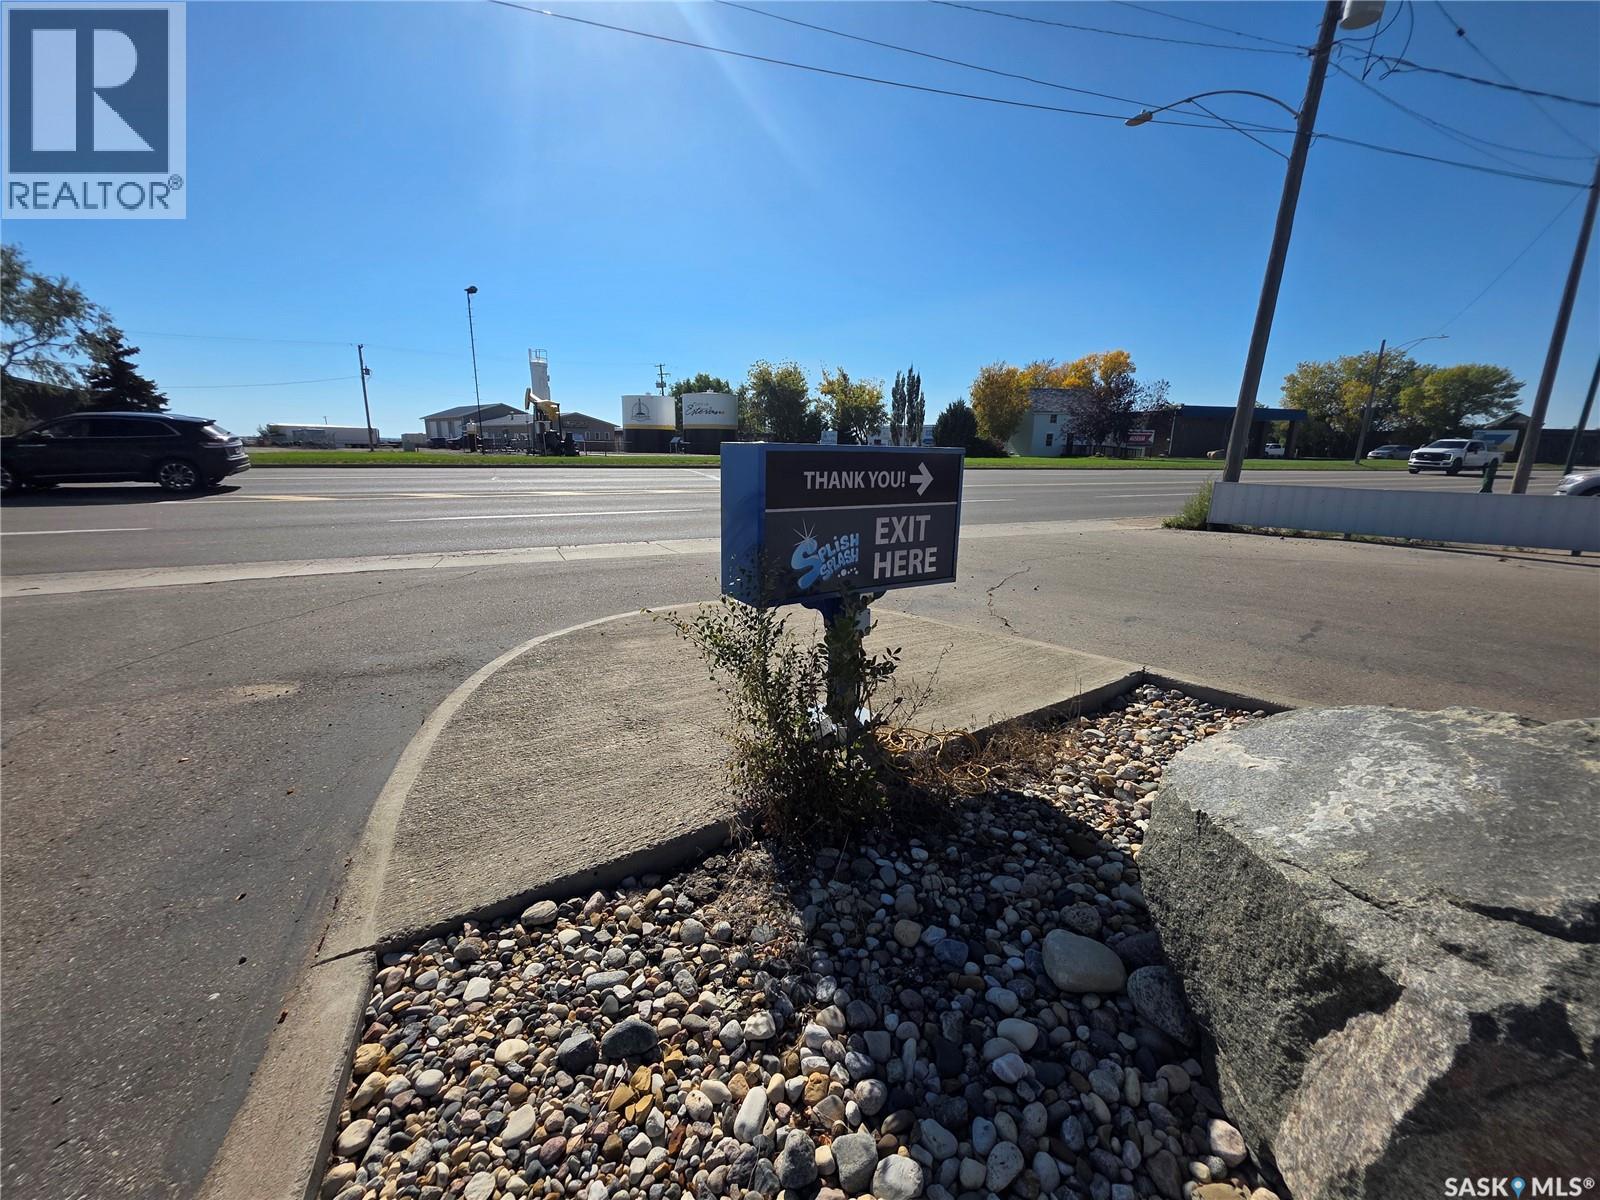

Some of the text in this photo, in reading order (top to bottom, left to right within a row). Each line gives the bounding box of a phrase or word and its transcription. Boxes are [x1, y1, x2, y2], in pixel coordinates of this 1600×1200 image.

[804, 470, 906, 490] THANK YOU!
[875, 514, 931, 545] EXIT
[820, 547, 859, 580] SPLASH
[873, 547, 938, 580] HERE
